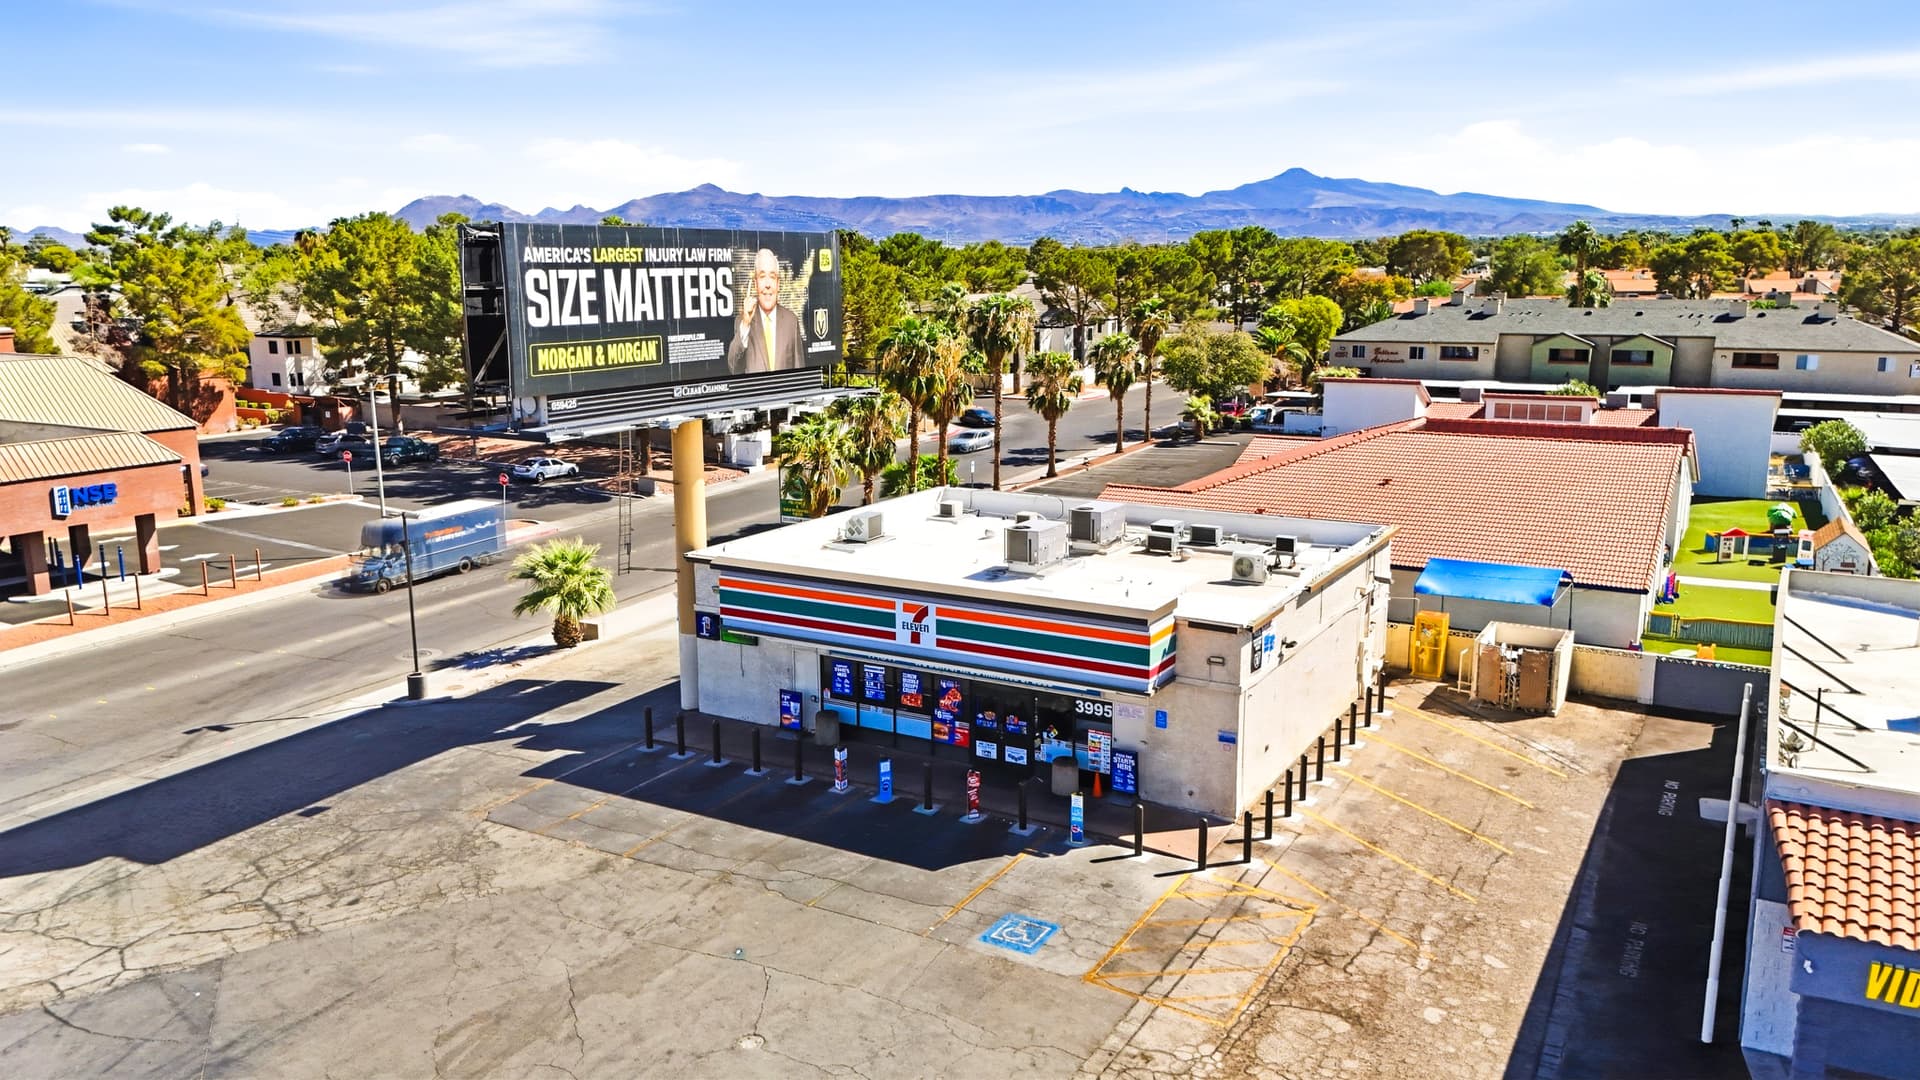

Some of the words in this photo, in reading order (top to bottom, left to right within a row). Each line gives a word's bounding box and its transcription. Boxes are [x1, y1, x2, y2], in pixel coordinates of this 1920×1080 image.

[523, 246, 592, 264] AMERICA'S
[593, 247, 644, 263] LARGEST
[645, 247, 683, 263] INJURY
[685, 247, 707, 263] LAW
[708, 247, 732, 263] FIRM
[525, 267, 600, 328] SIZE
[603, 266, 734, 323] MATTERS
[537, 344, 593, 371] MORGAN
[595, 345, 606, 367] &
[608, 340, 657, 364] MORGAN
[71, 483, 117, 505] NSB
[1075, 700, 1113, 718] 3995
[1663, 779, 1680, 790] NO
[1865, 960, 1920, 1010] VID
